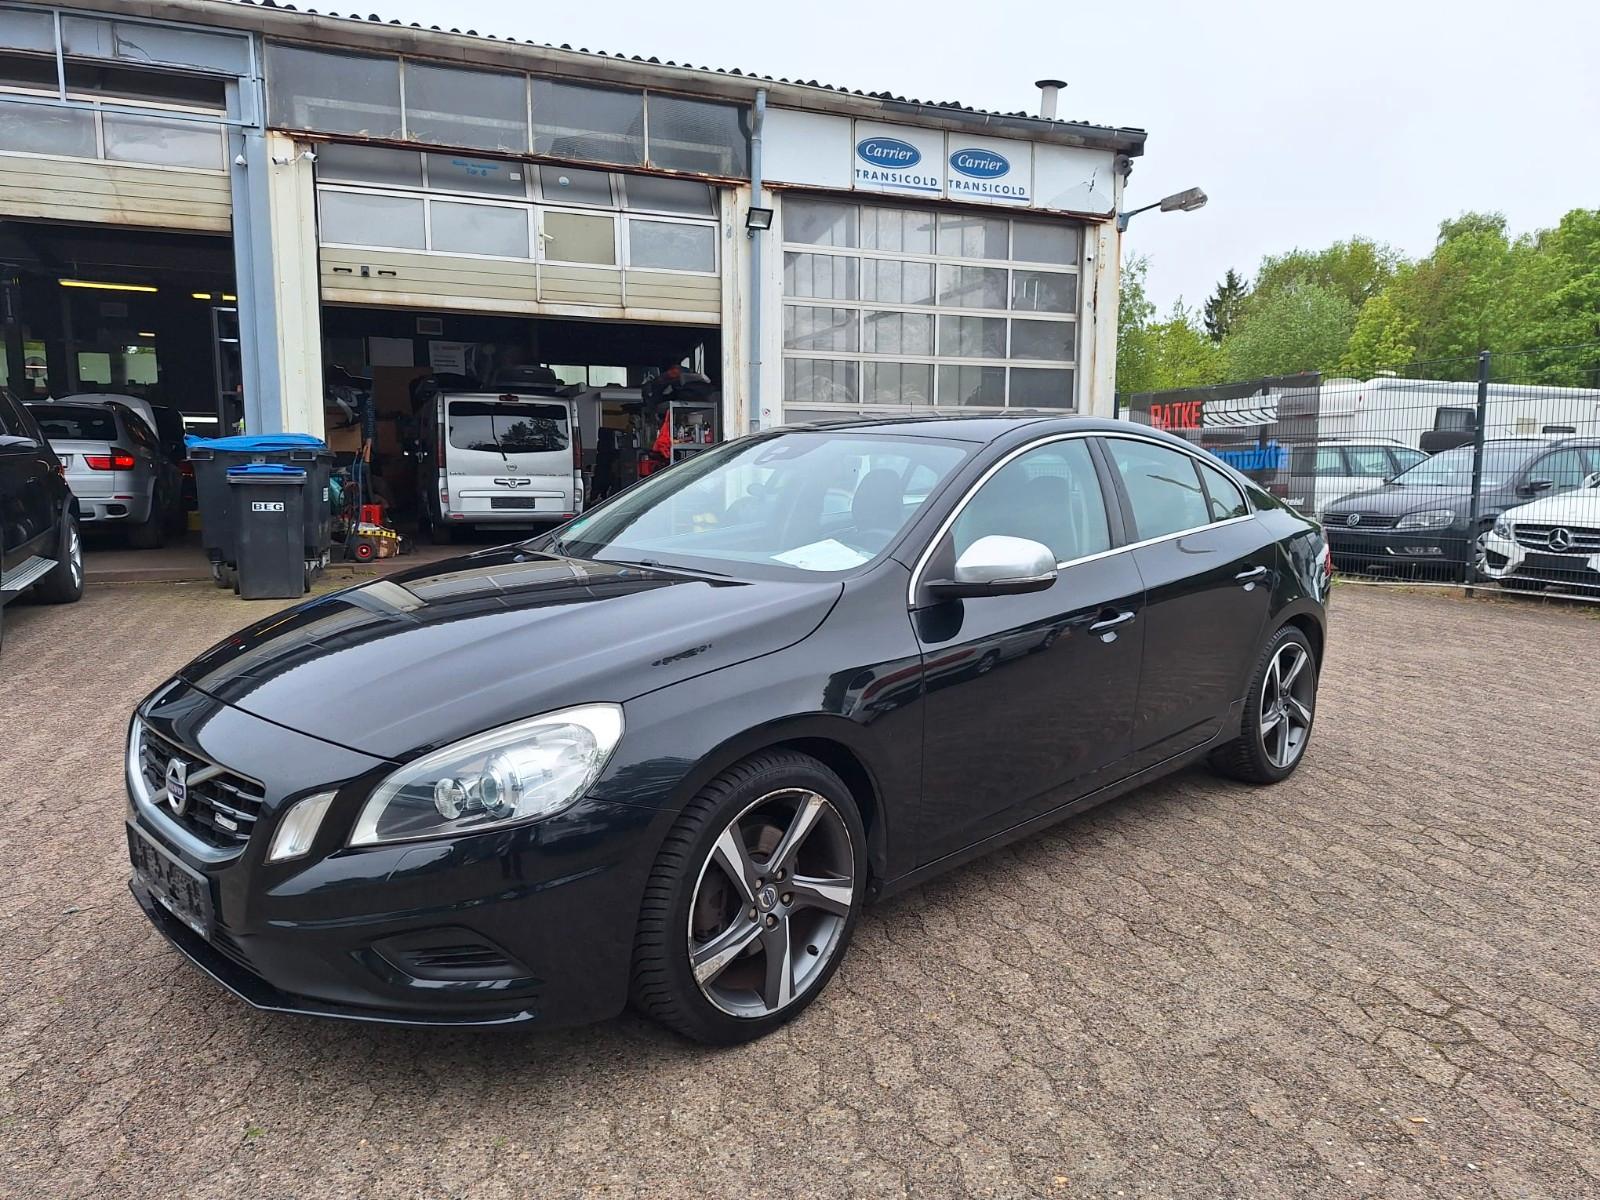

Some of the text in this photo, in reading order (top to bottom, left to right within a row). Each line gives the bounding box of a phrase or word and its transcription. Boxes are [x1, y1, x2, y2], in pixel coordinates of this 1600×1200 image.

[865, 143, 913, 161] Carrier
[957, 154, 1003, 171] Carrier
[856, 169, 938, 186] TRANSICOLD
[948, 180, 1025, 195] TRANSICOLD
[1151, 401, 1202, 430] RATKE
[253, 503, 283, 511] BEG
